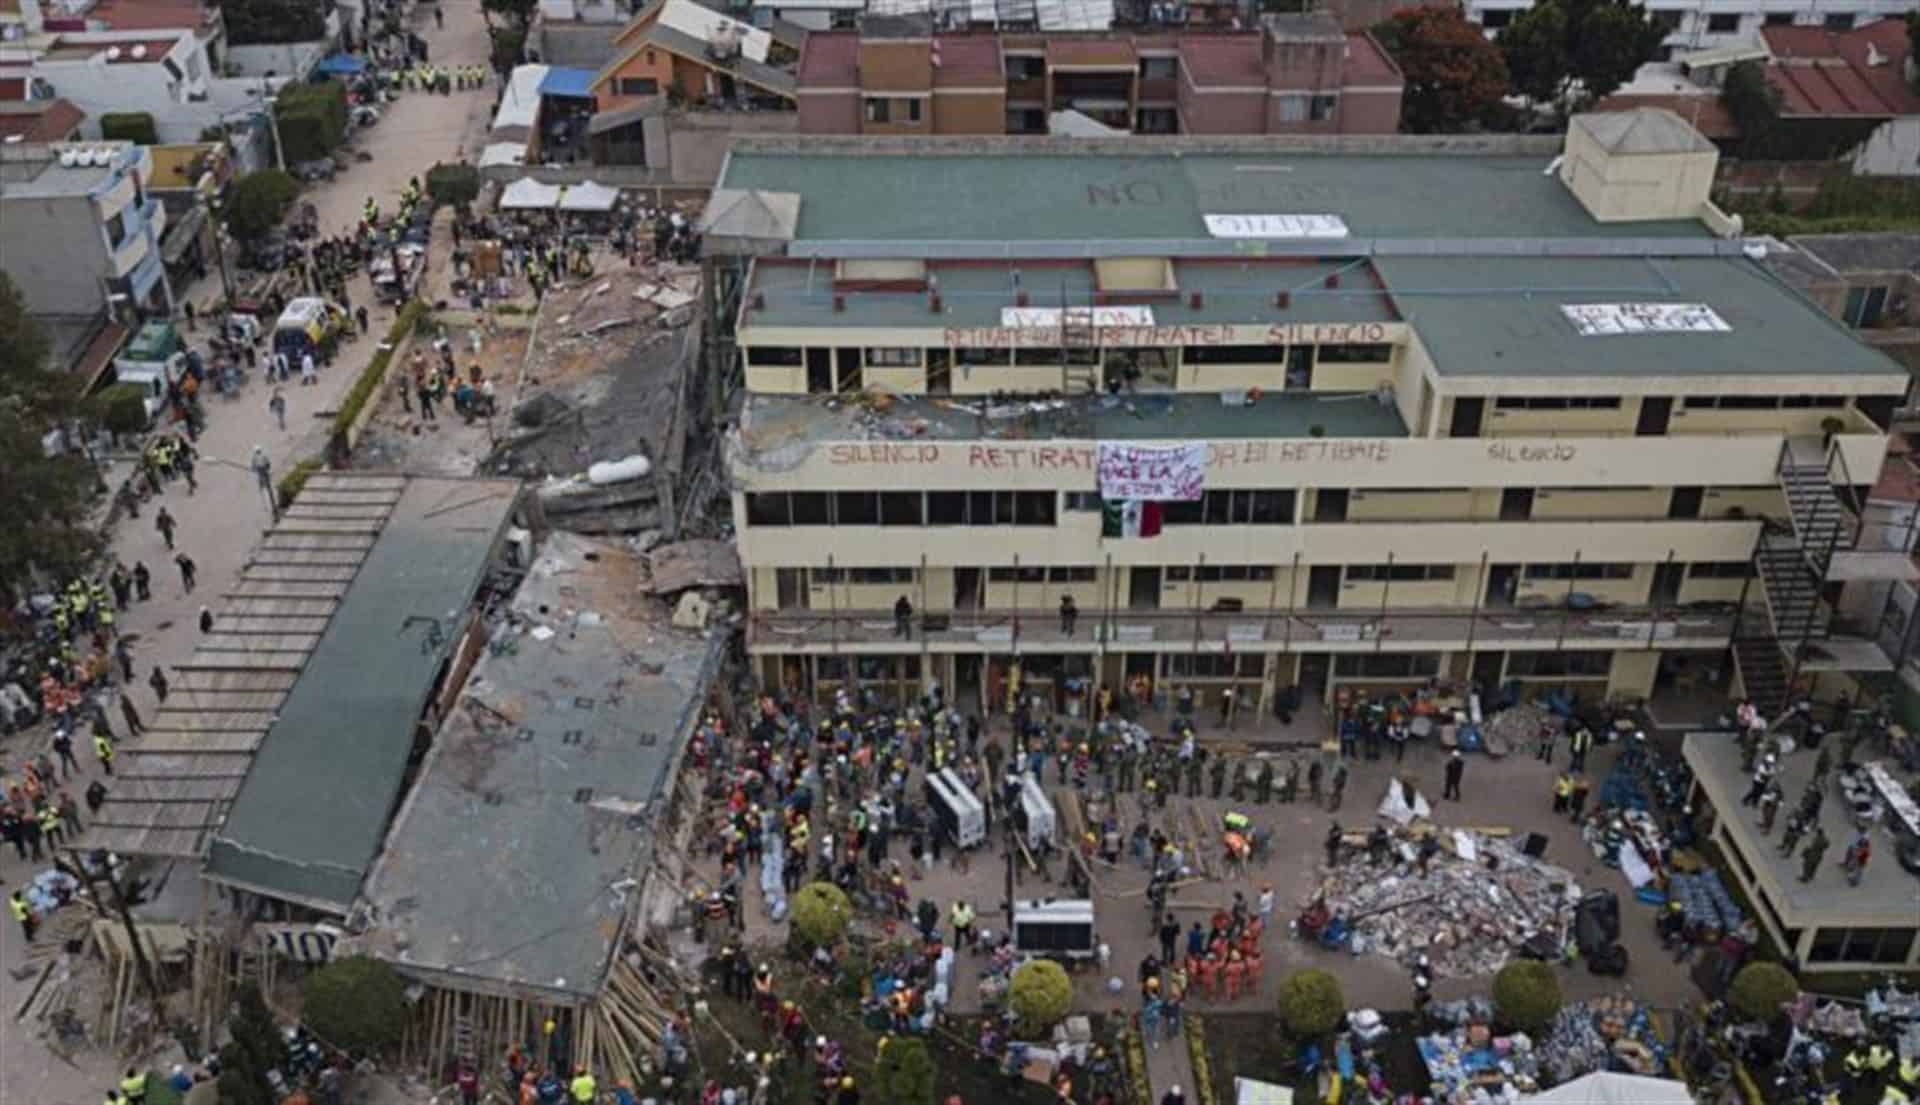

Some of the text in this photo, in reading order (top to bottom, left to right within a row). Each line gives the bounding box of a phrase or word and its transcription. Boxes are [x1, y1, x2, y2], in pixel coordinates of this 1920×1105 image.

[829, 444, 939, 465] SILENCIO
[969, 444, 1095, 470] RETIRAT
[1148, 463, 1173, 480] LA
